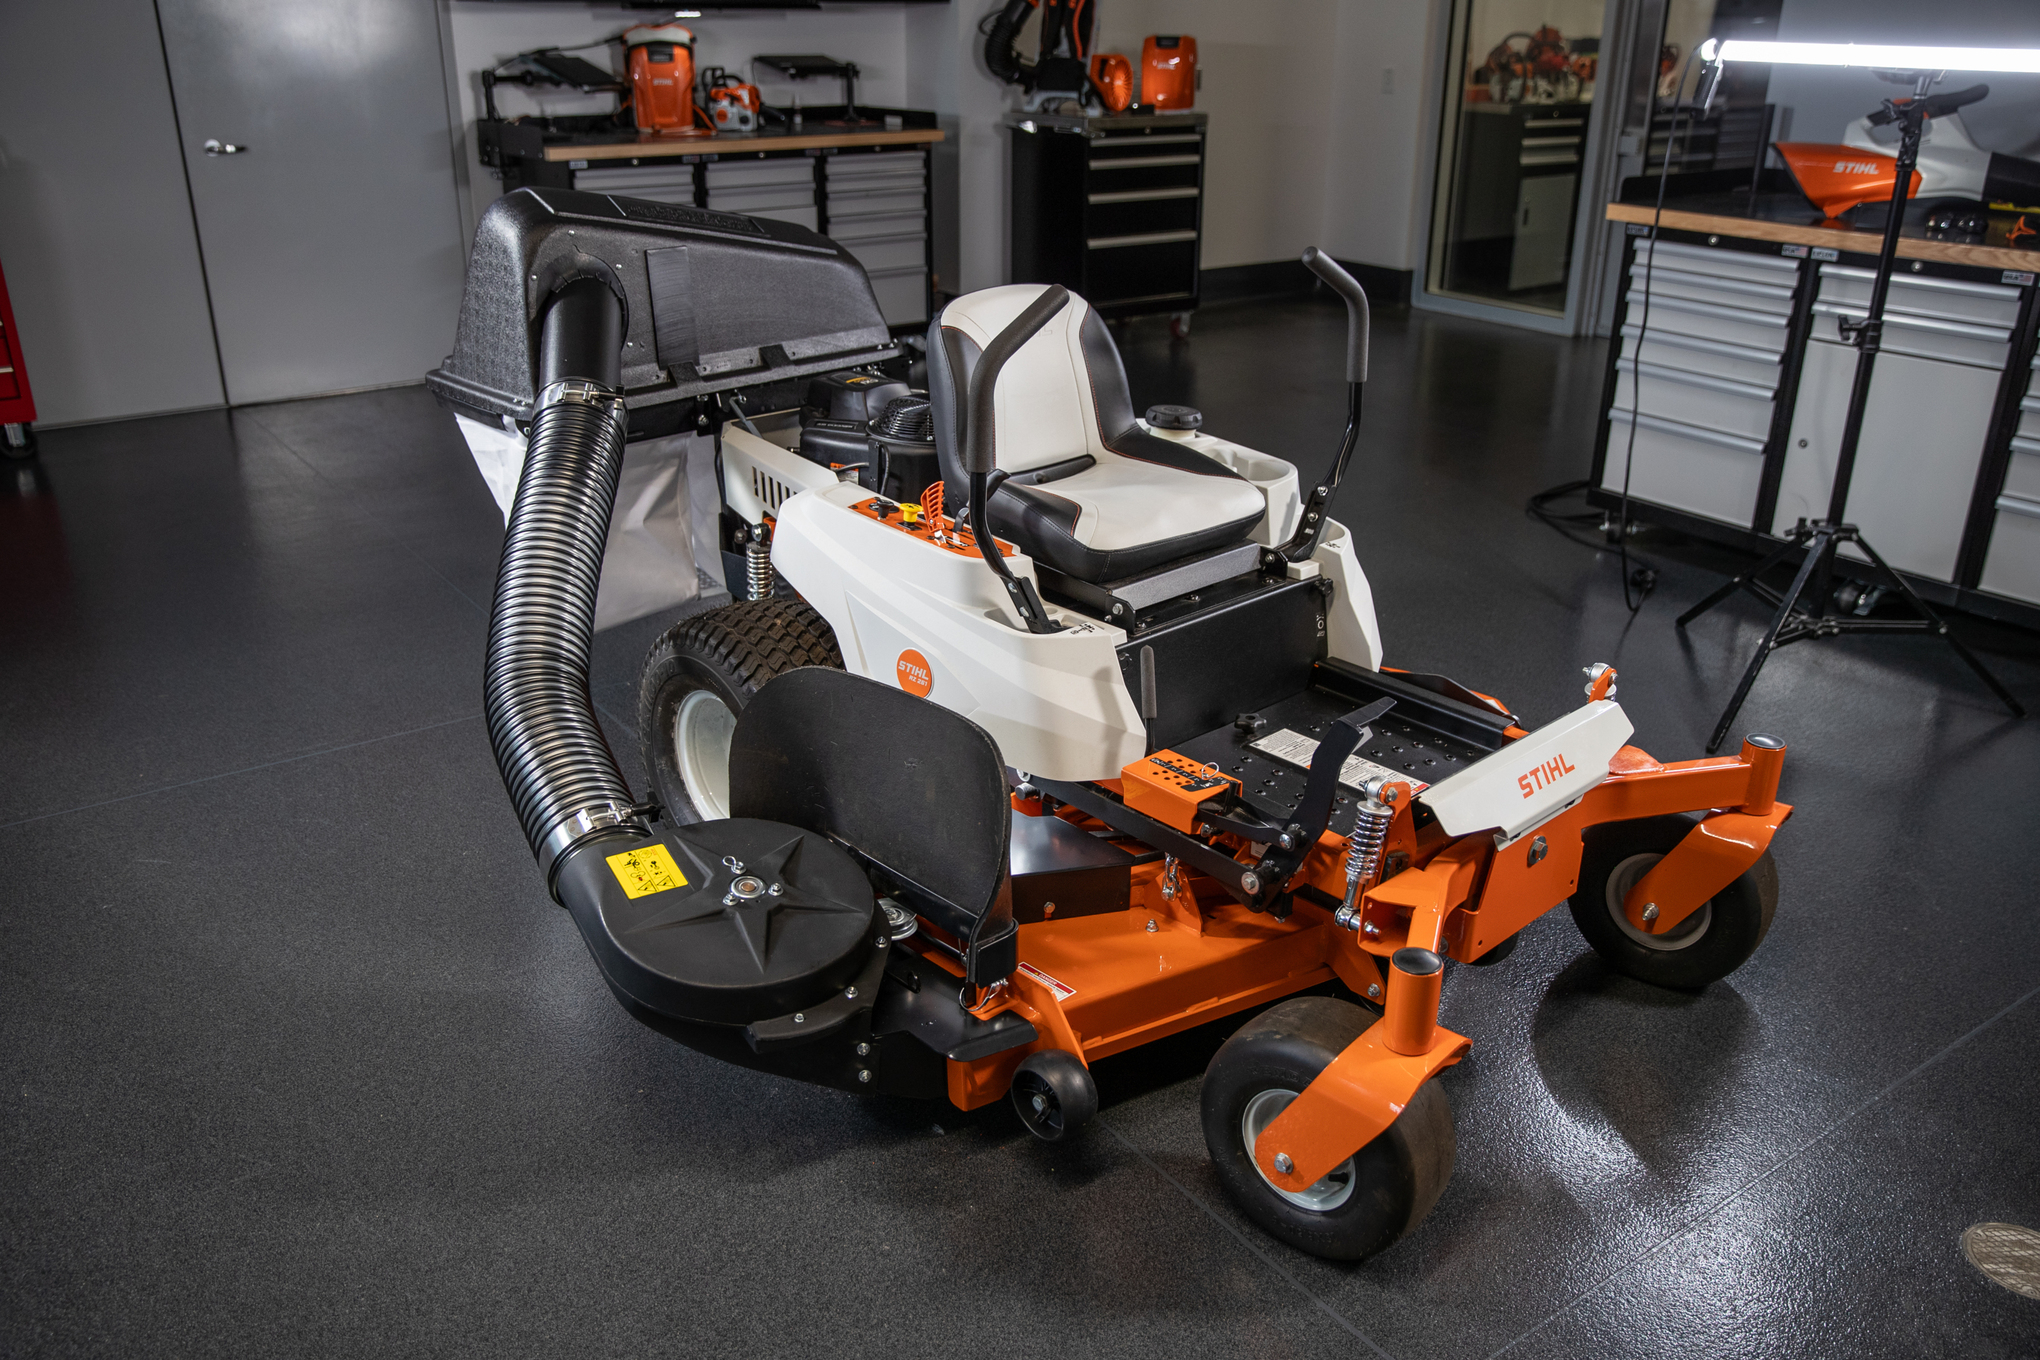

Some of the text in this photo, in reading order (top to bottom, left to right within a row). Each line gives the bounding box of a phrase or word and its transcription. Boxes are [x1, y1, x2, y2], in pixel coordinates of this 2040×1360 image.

[1832, 161, 1879, 175] STIHL
[898, 660, 929, 681] STIHL
[908, 674, 917, 683] RZ
[1517, 753, 1576, 800] STIHL
